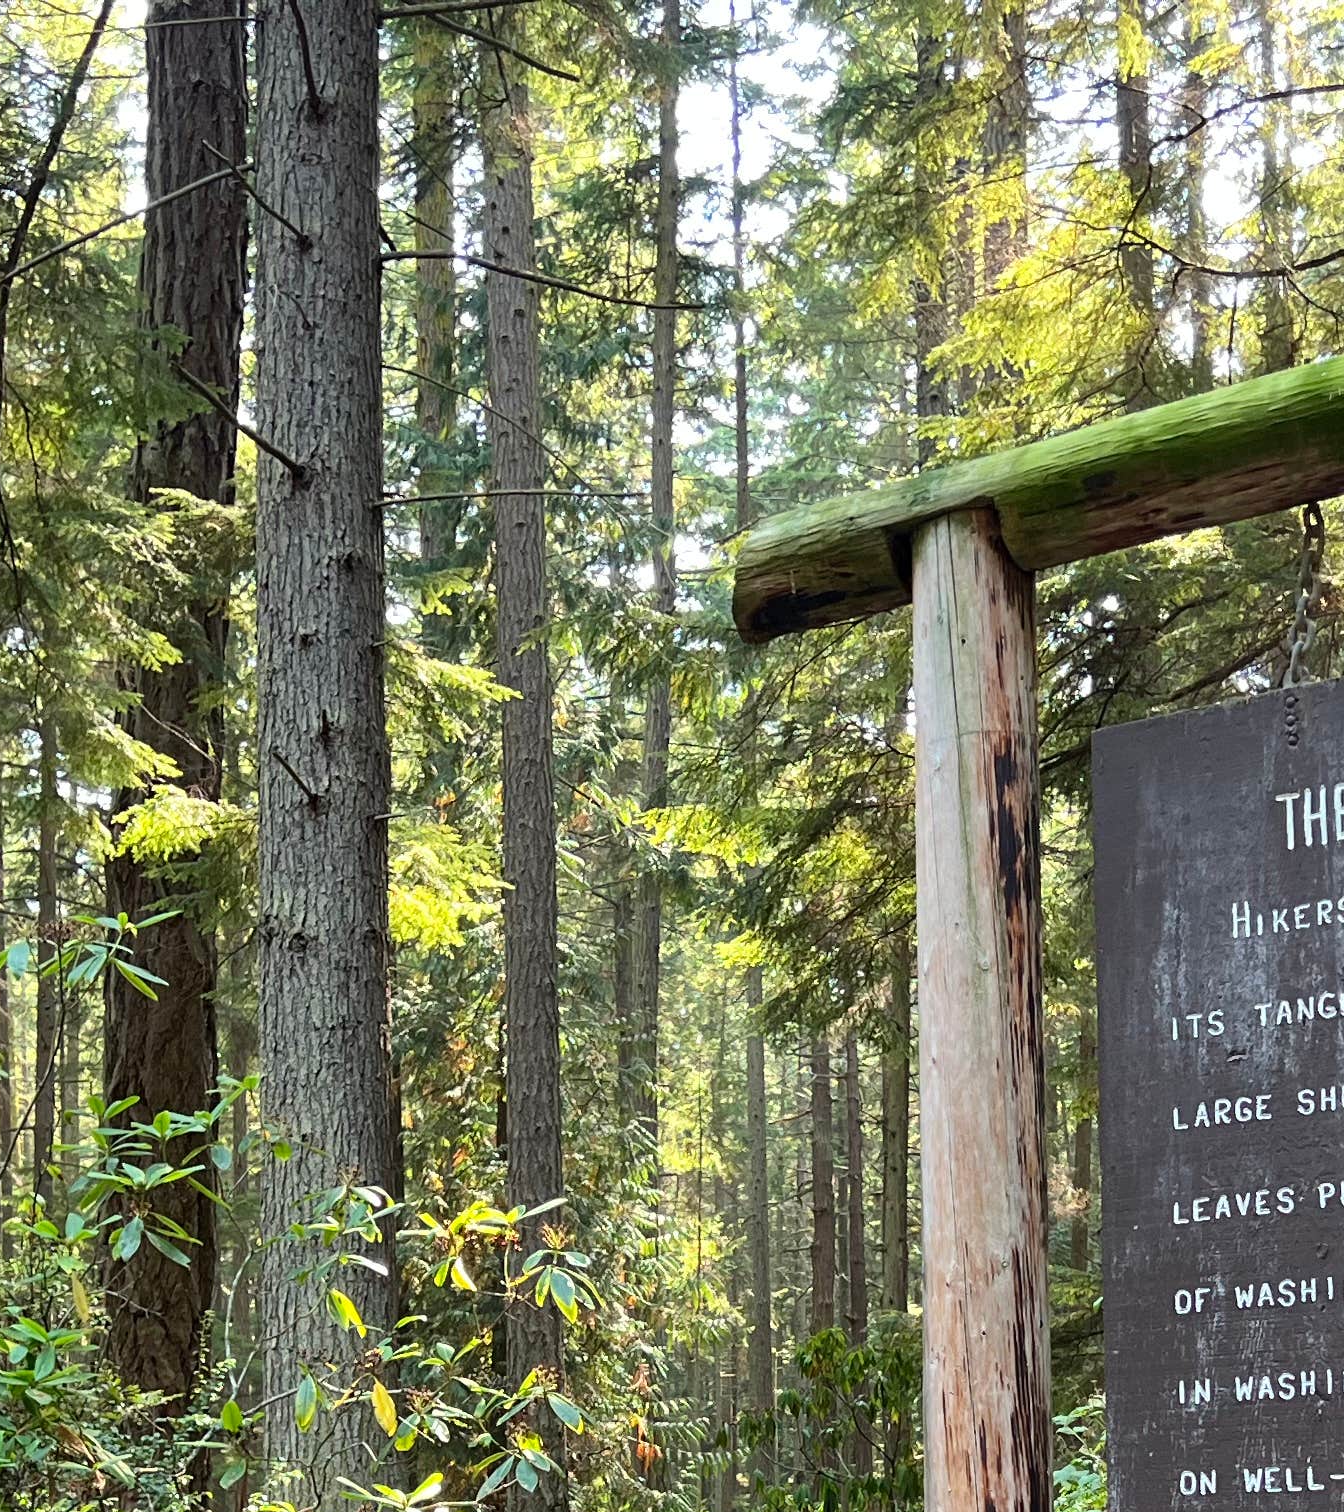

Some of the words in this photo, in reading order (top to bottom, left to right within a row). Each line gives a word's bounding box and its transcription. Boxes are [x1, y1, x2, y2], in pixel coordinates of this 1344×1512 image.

[1171, 1008, 1225, 1041] ITS
[1172, 1094, 1272, 1130] LARGE
[1173, 1186, 1295, 1225] LEAVES
[1174, 1287, 1211, 1315] OF
[1178, 1378, 1211, 1405] IN
[1179, 1469, 1217, 1496] ON
